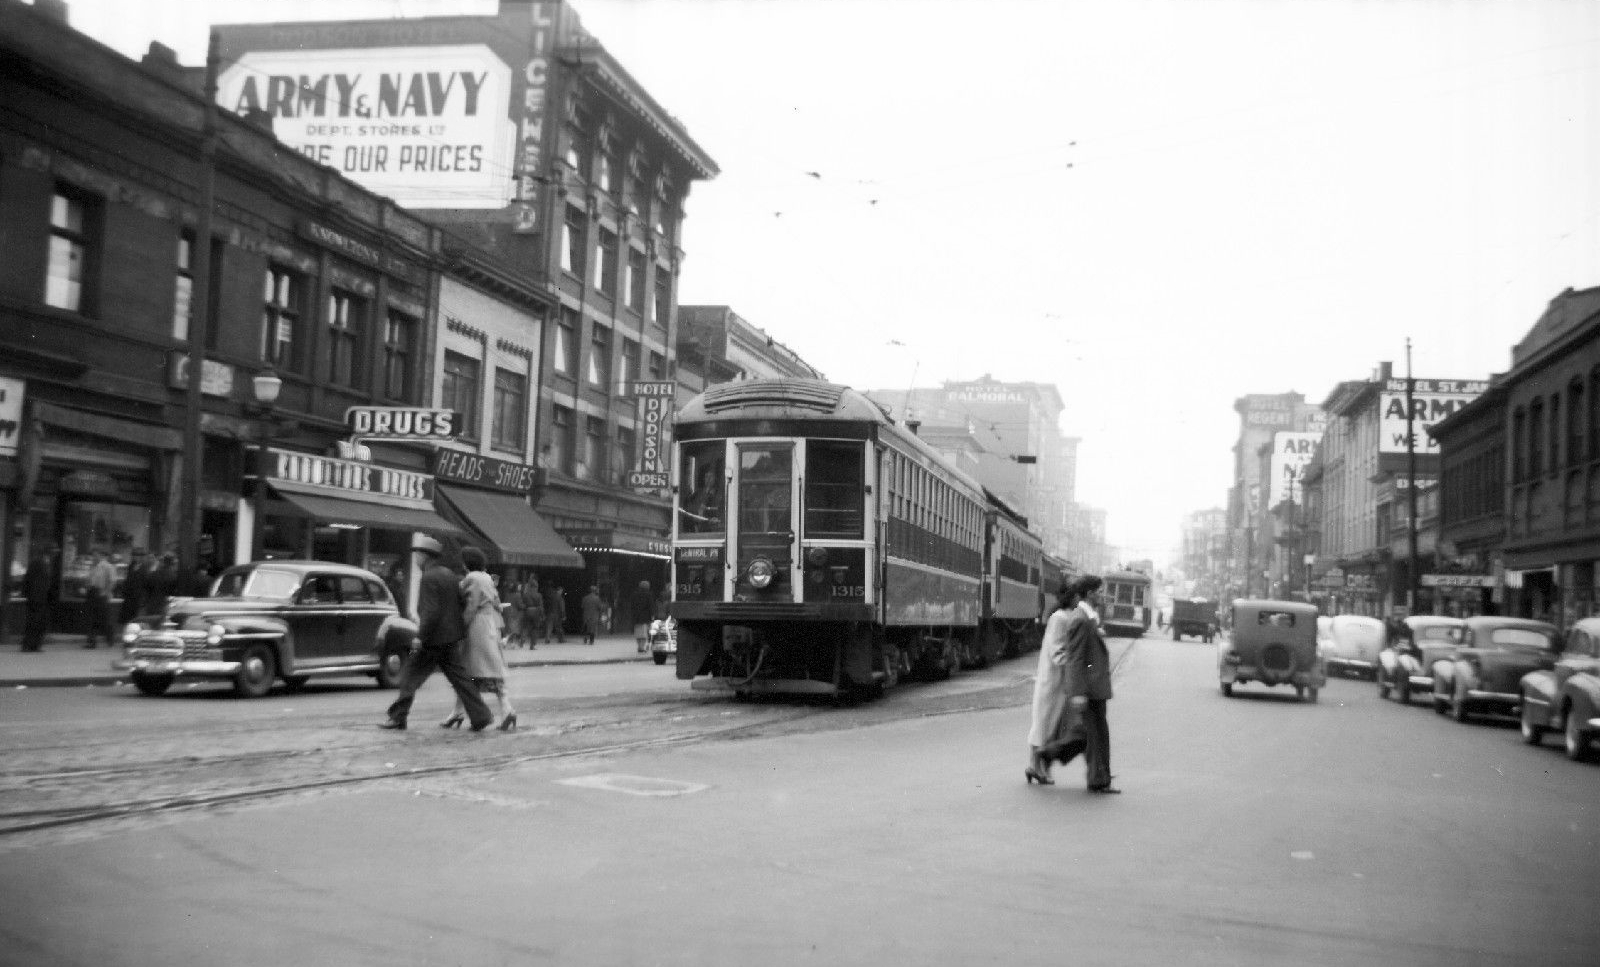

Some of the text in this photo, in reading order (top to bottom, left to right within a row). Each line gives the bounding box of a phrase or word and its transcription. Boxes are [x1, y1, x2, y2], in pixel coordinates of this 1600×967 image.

[235, 71, 490, 119] ARMY & NAVY
[305, 125, 352, 136] DEPT.
[357, 125, 421, 136] STORES
[344, 144, 389, 173] OUR
[399, 144, 484, 173] PRICES
[634, 383, 673, 395] HOTEL
[965, 385, 1009, 393] HOTEL
[1386, 380, 1431, 391] HOEL
[354, 410, 454, 436] DRUGS
[644, 398, 659, 471] DODSON
[437, 450, 535, 491] HEADS SHOES
[630, 473, 666, 486] OPEN
[831, 585, 865, 597] 1315
